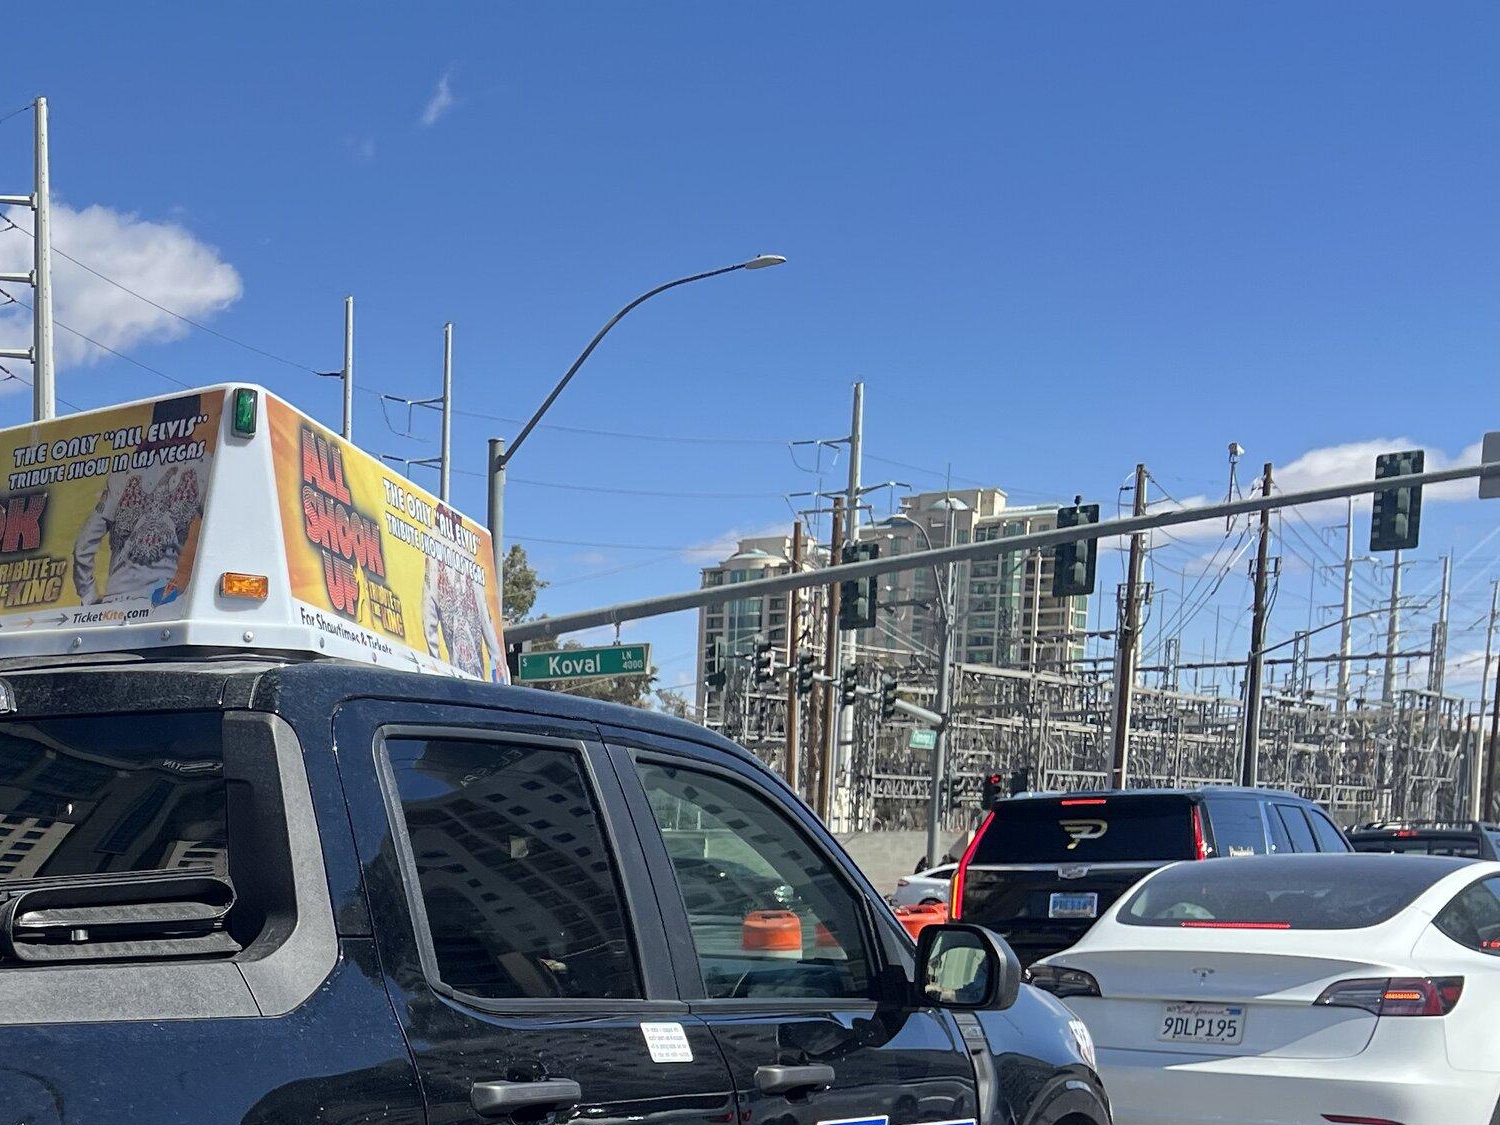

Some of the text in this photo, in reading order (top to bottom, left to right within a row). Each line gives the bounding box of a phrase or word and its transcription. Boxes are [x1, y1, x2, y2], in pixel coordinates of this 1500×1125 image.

[9, 440, 206, 491] TRIBUTE SHOW IN LAS VEGAS
[14, 442, 47, 468] THE
[51, 433, 101, 461] ONLY
[301, 428, 351, 506] ALL
[383, 477, 405, 513] THE
[406, 492, 432, 529] ONLY
[302, 485, 385, 578] SHOOK
[385, 510, 420, 550] TRIBUTE
[420, 531, 443, 561] SHOW
[51, 560, 67, 576] TO
[322, 550, 359, 615] UP
[5, 577, 63, 607] KING
[300, 606, 315, 627] For
[522, 651, 632, 676] S Koval LN
[622, 660, 643, 670] 4000
[1163, 1017, 1237, 1038] 9DLP195
